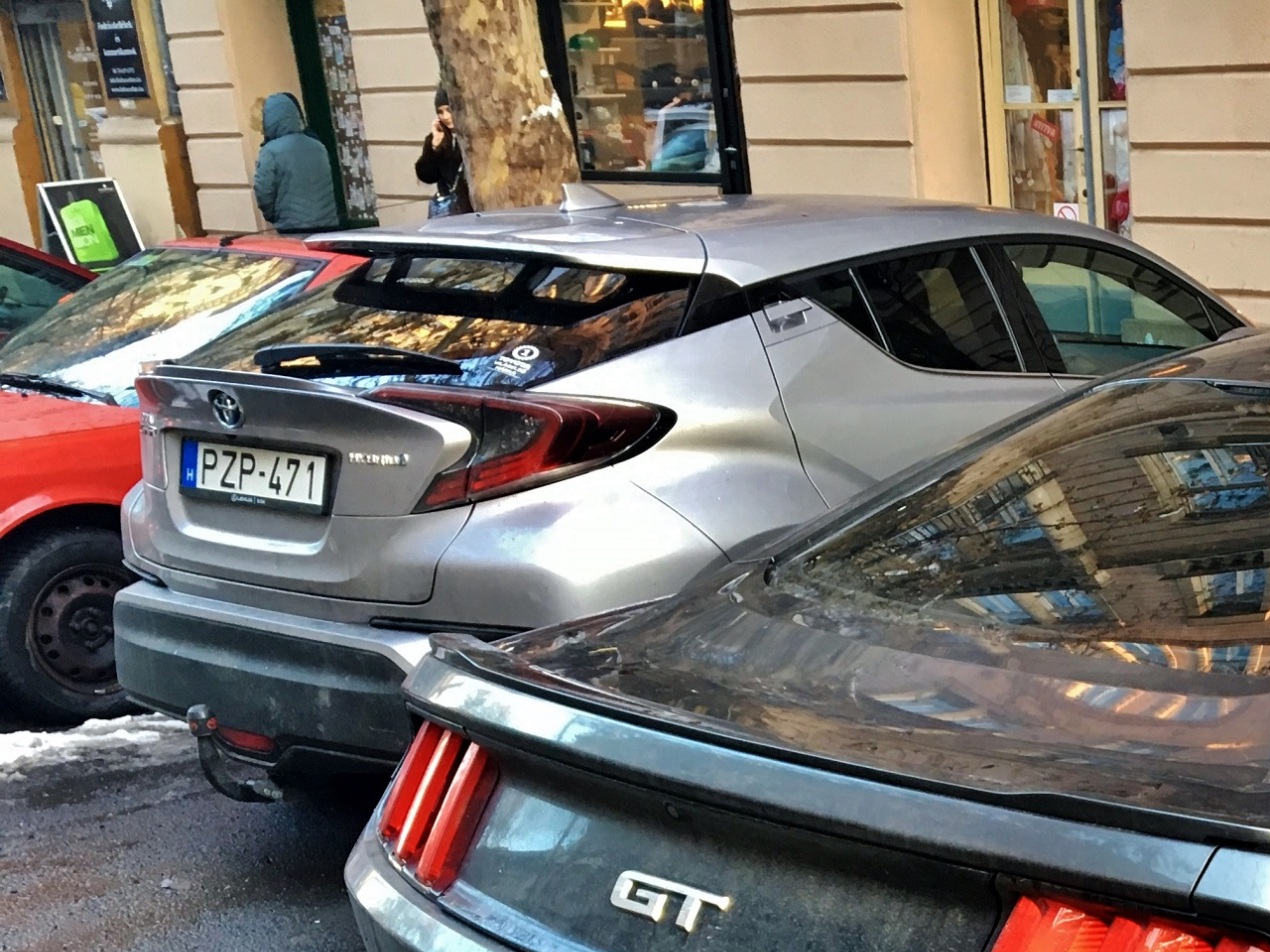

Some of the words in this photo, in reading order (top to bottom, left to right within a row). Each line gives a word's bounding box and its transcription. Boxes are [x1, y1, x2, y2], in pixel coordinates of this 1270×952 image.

[186, 468, 194, 481] H
[202, 448, 316, 500] PZP-471
[610, 869, 730, 932] GT
